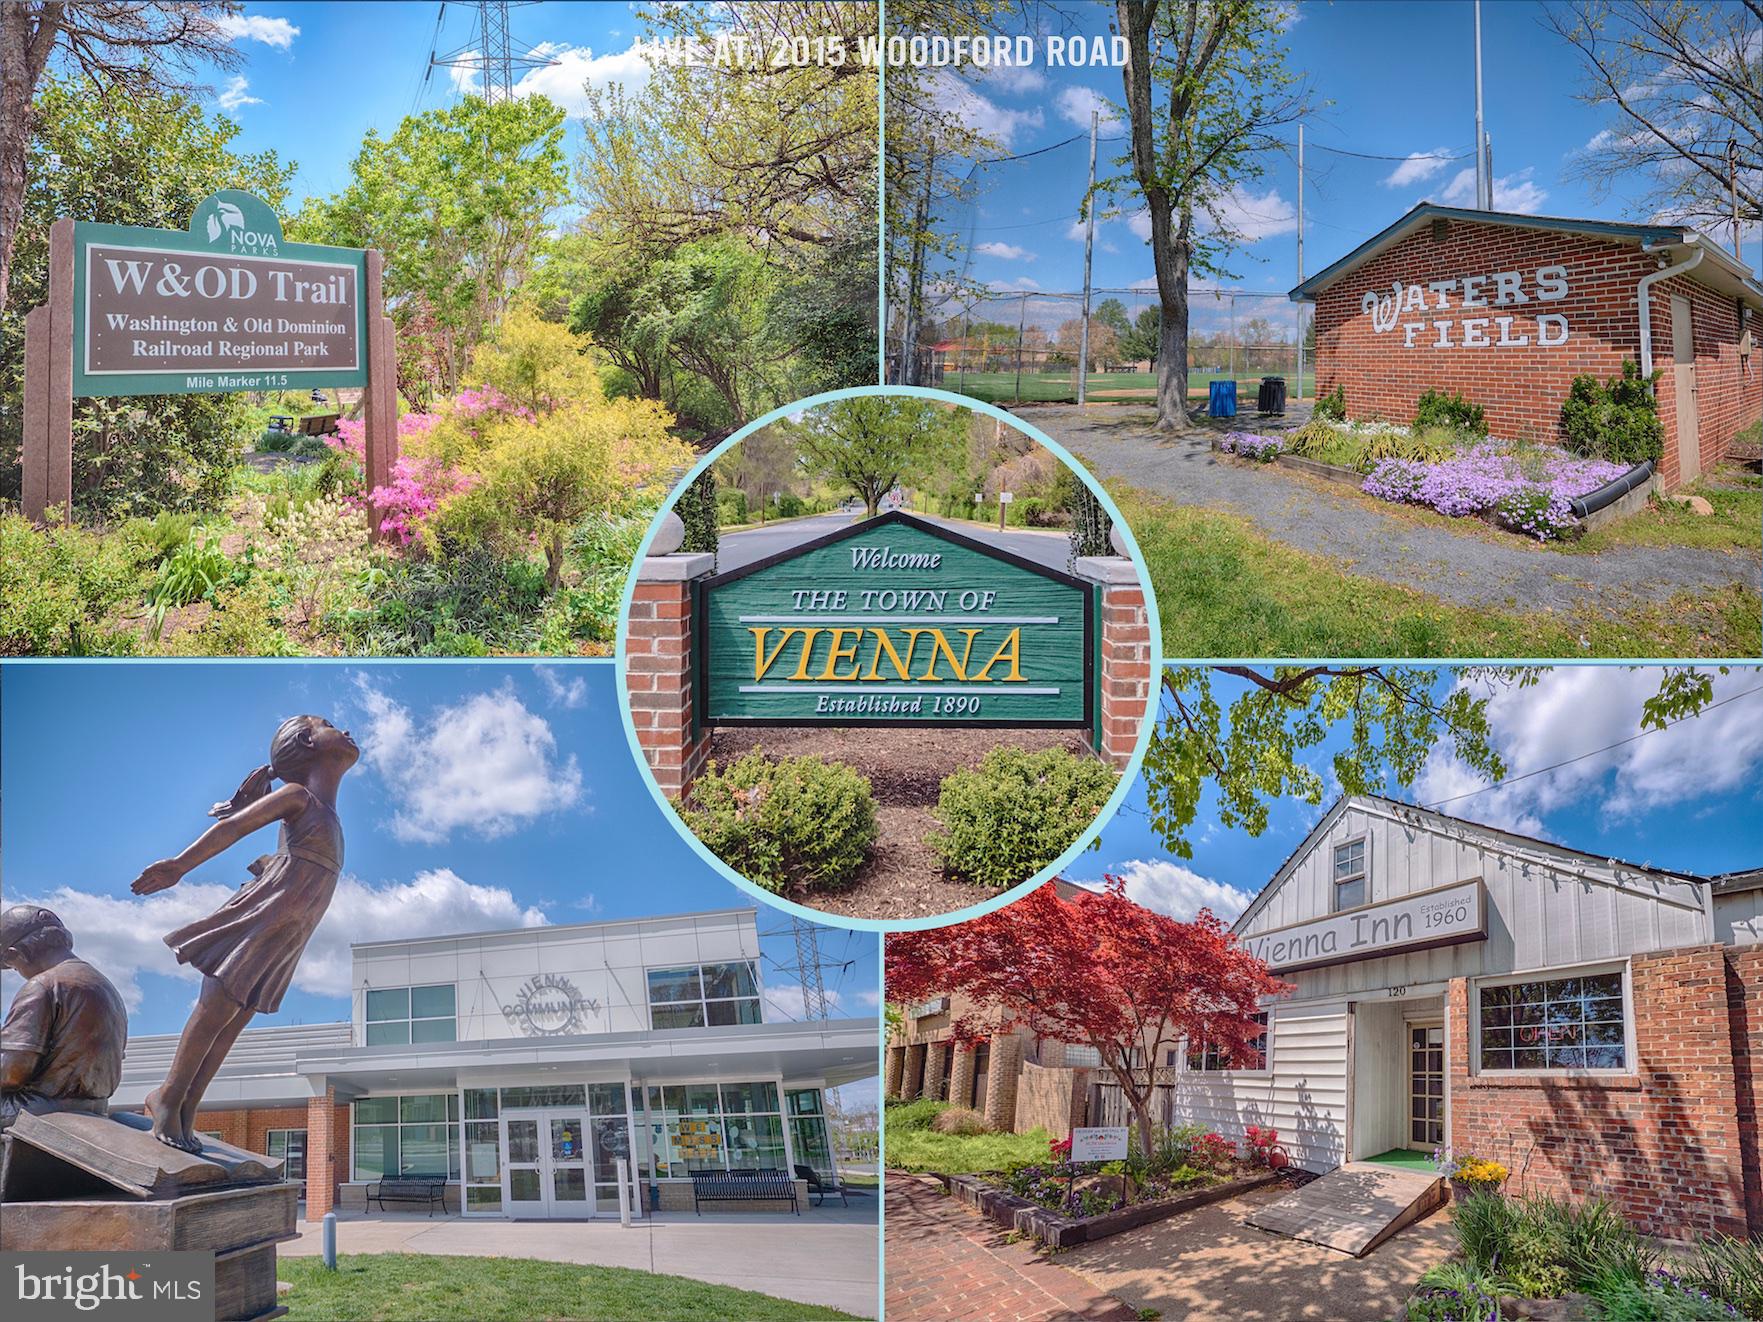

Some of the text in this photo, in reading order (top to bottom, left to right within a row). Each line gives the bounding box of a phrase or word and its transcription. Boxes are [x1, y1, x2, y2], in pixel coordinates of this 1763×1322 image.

[231, 229, 278, 249] NOVA
[231, 245, 279, 257] PARKS
[104, 258, 348, 305] W&OD Trail
[1361, 265, 1569, 334] WATERS
[106, 313, 347, 336] Washington & Old Dominion
[1403, 313, 1569, 348] FIELD
[132, 340, 329, 359] Railroad Regional Park
[186, 375, 288, 389] Mile Marker 11.5
[850, 547, 942, 570] Welcome
[792, 590, 997, 612] THE TOWN OF
[748, 626, 1029, 683] VIENNA
[815, 695, 981, 714] Established 1890
[1420, 895, 1472, 914] Established
[1425, 906, 1467, 929] 1960
[1248, 911, 1413, 963] Vienna Inn
[1388, 986, 1406, 998] 120
[501, 999, 598, 1017] COMMUNITY
